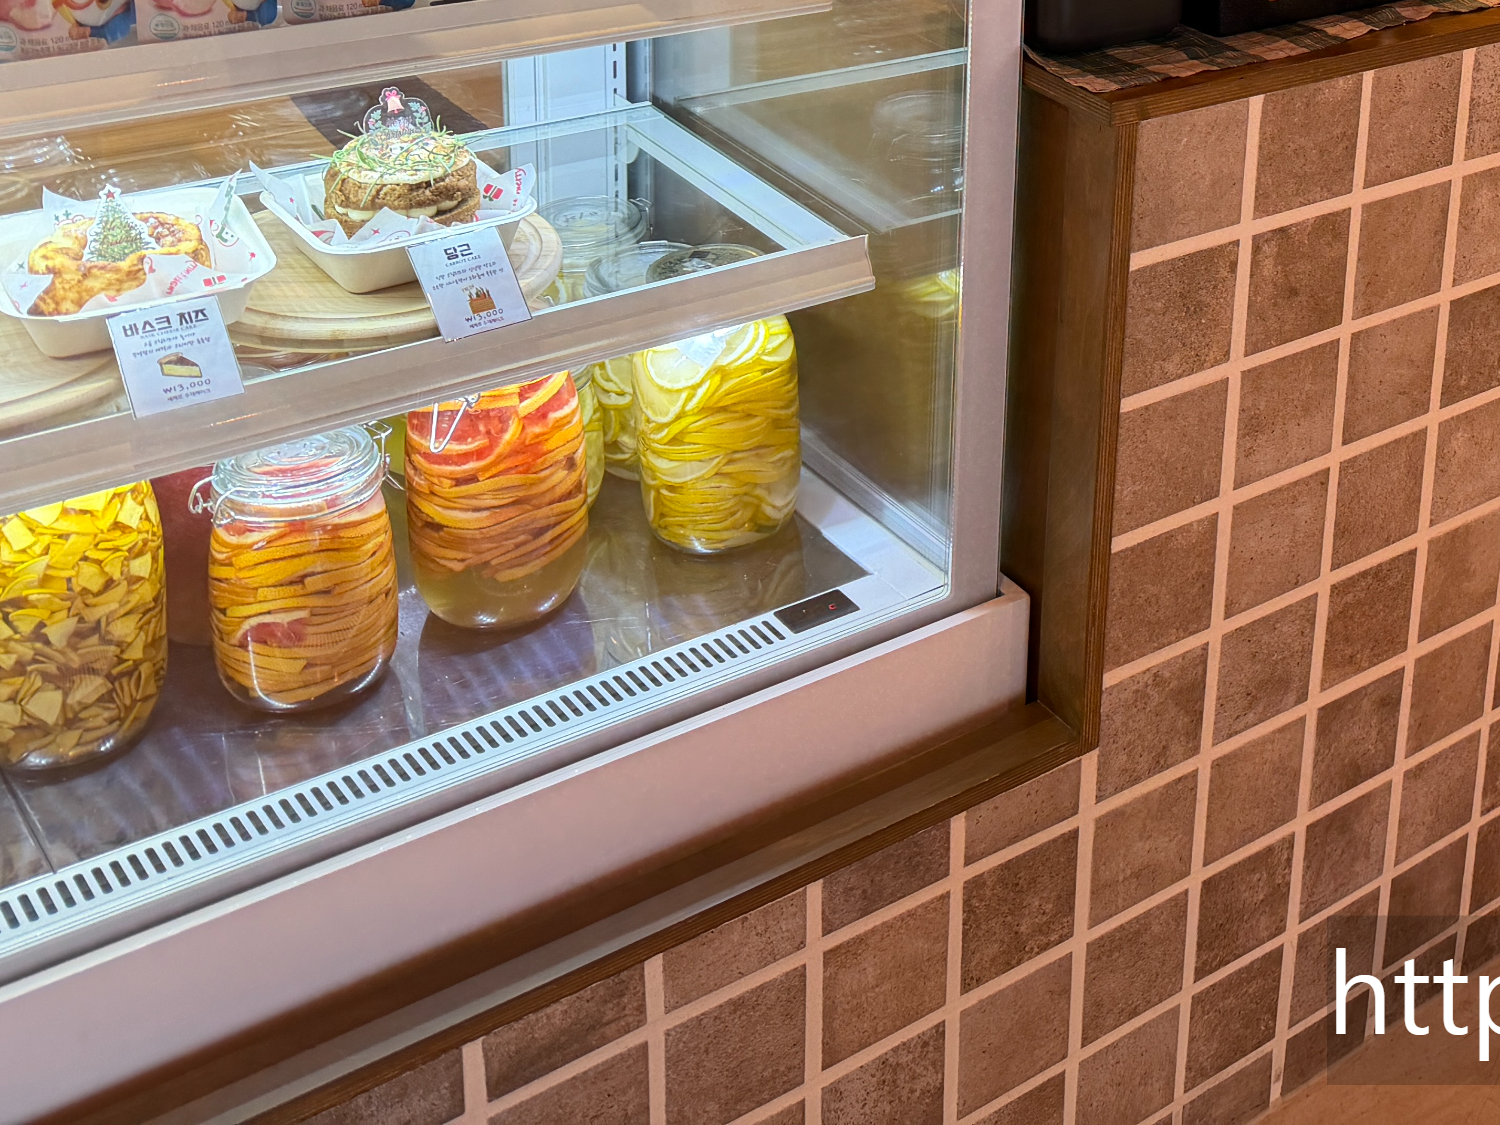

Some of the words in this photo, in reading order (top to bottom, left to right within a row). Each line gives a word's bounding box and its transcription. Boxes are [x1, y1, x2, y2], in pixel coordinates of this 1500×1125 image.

[443, 242, 474, 261] 당근
[445, 258, 467, 268] CARROT
[467, 254, 482, 262] CAKE
[122, 315, 173, 338] 바스크
[176, 307, 209, 326] 치즈
